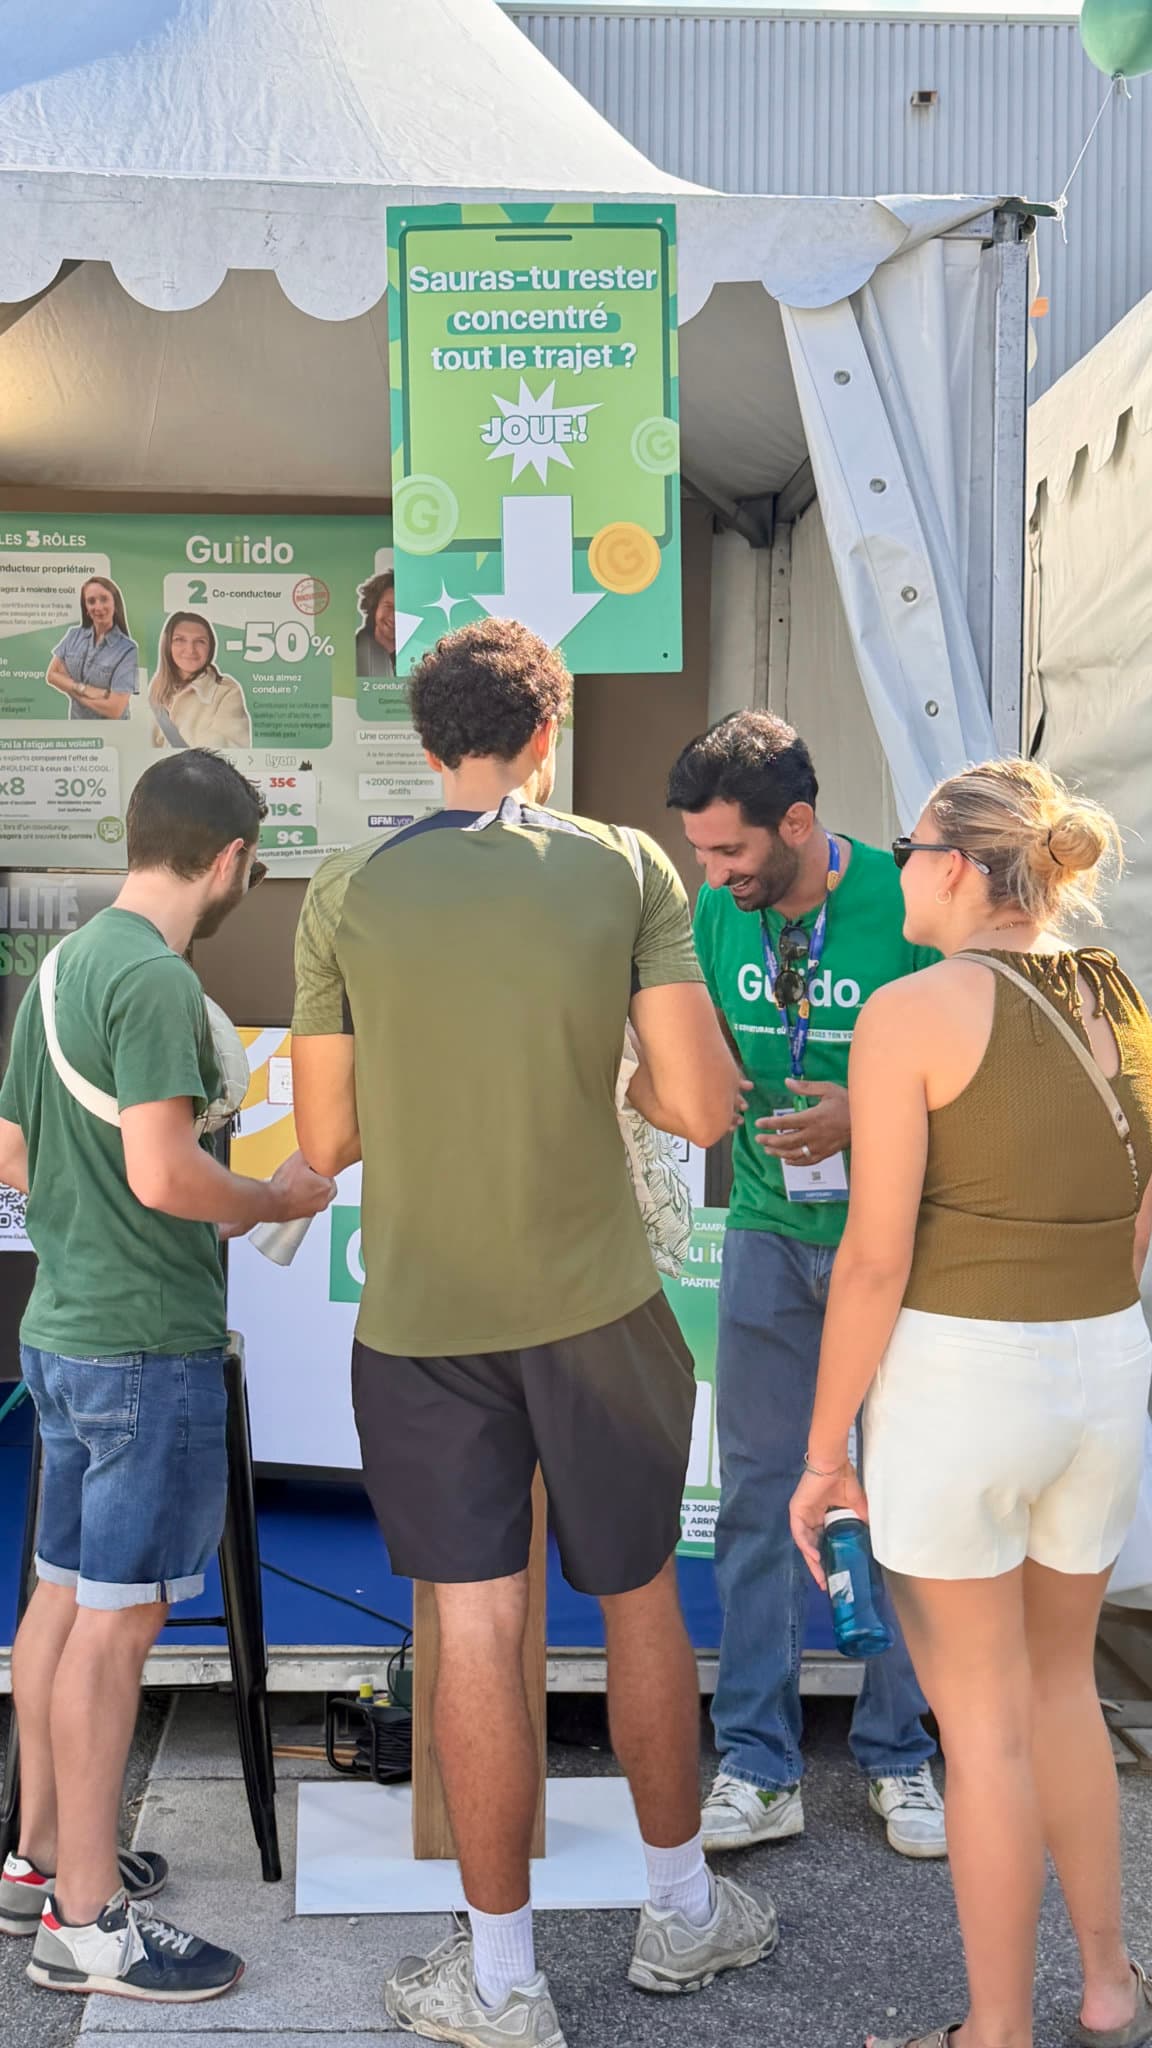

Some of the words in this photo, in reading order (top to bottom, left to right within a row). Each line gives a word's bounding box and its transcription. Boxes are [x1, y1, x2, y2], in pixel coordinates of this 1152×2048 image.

[409, 265, 561, 292] Sauras-tu
[568, 265, 657, 289] rester
[453, 301, 608, 331] concentré
[431, 346, 493, 371] tout
[500, 344, 526, 370] le
[532, 342, 613, 375] trajet
[620, 342, 638, 369] ?
[26, 530, 40, 548] 3
[42, 531, 87, 546] RÔLES
[185, 535, 294, 564] Guiido
[42, 565, 96, 574] propriétaire
[187, 579, 208, 604] 2
[212, 588, 282, 598] Co-conducteur
[12, 670, 45, 679] voyage
[252, 673, 274, 682] Vous
[275, 673, 302, 682] aimez
[252, 685, 291, 693] conduire
[362, 681, 370, 691] 2
[265, 753, 297, 768] Lyon
[0, 776, 25, 796] x8
[55, 777, 107, 797] 30%
[269, 777, 297, 788] 35€
[269, 803, 303, 817] 19€
[276, 830, 304, 846] 9€
[738, 963, 861, 1008] Gudo
